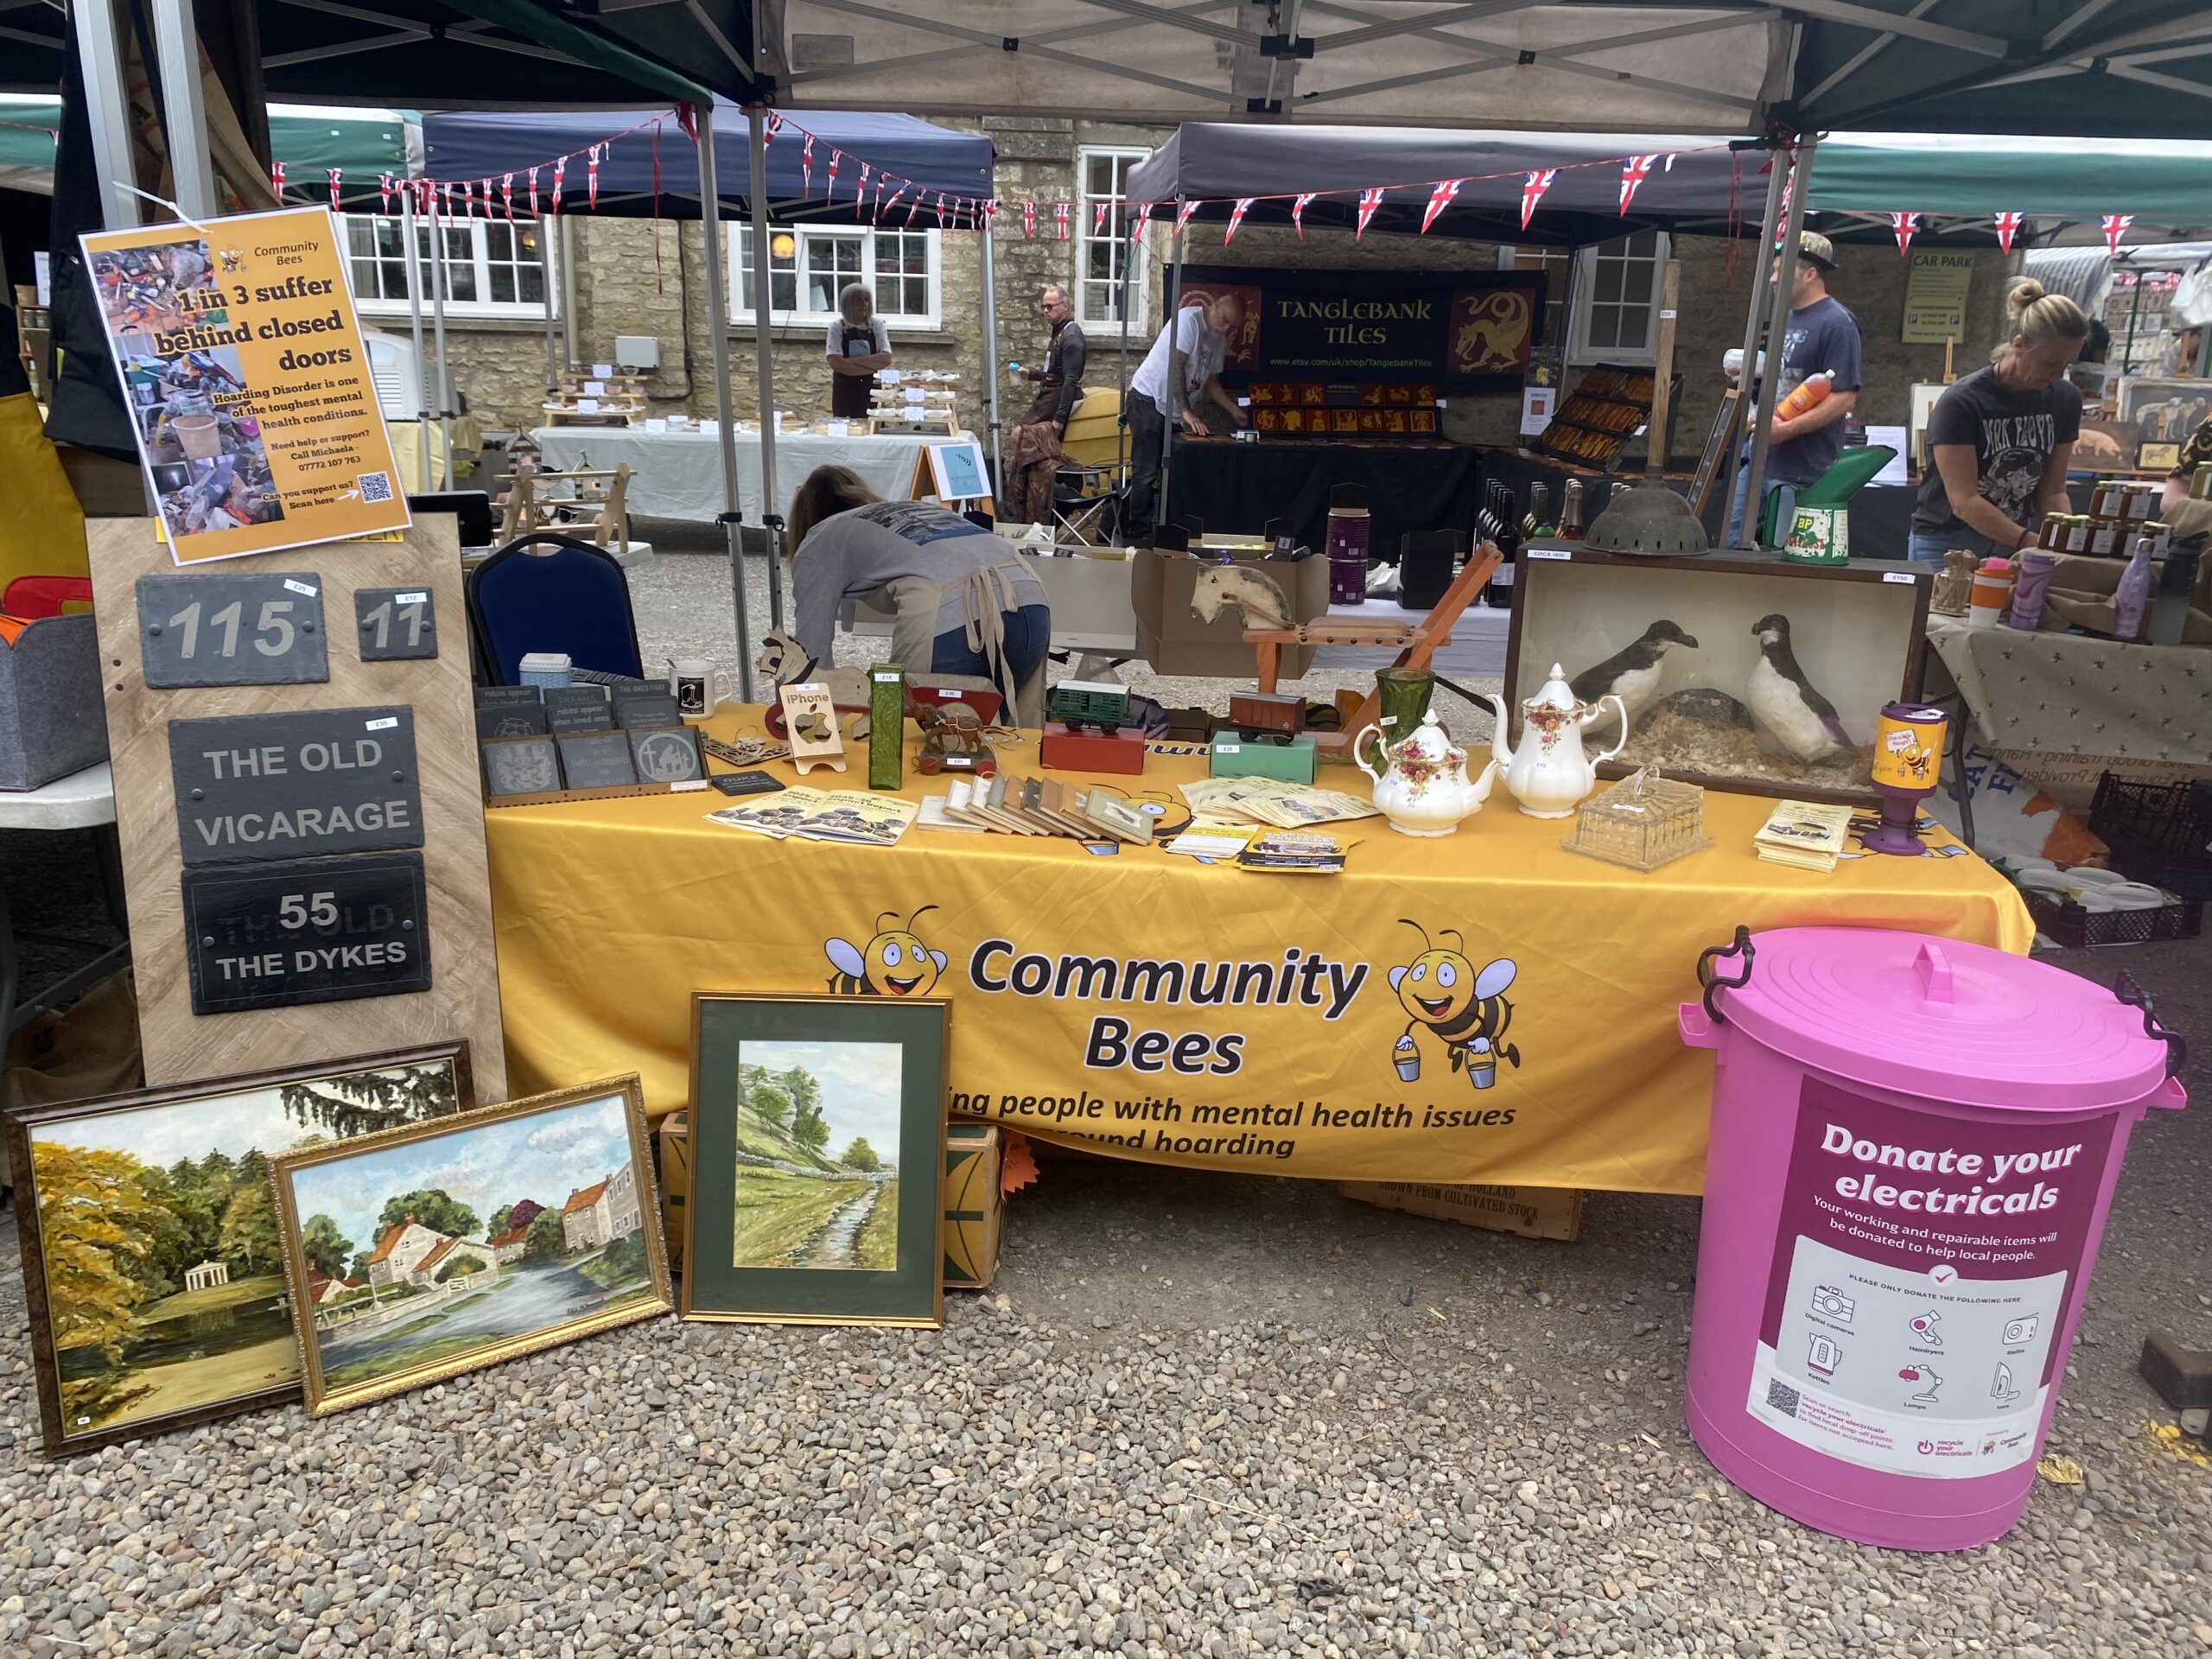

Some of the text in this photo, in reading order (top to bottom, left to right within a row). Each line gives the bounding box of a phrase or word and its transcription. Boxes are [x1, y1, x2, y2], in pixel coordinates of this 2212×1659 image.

[254, 241, 319, 257] Community
[276, 255, 302, 266] Bees
[1913, 255, 1972, 267] CAR PARK
[177, 276, 333, 312] 1 in 3 suffer
[1277, 298, 1433, 321] TANGLEBANK
[153, 309, 345, 354] behind closed
[1324, 323, 1387, 346] TILES
[278, 347, 353, 371] doors
[213, 378, 359, 404] Hoarding Disorder is one
[232, 390, 364, 418] of the toughest mental
[261, 408, 368, 429] health conditions.
[270, 440, 296, 451] Need
[296, 437, 318, 448] help
[331, 429, 370, 442] support?
[290, 445, 354, 460] Call Michaela
[299, 455, 361, 472] 07772 107 763
[263, 481, 354, 502] Can you support us?
[289, 495, 335, 510] Scan here
[1797, 518, 1812, 529] BP
[168, 601, 296, 659] 115
[365, 601, 423, 648] 11
[203, 739, 382, 779] THE OLD
[723, 775, 759, 783] DUKE
[195, 800, 410, 846] VICARAGE
[280, 891, 338, 929] 55
[216, 941, 407, 980] THE DYKES
[971, 939, 1368, 1019] Community
[1087, 1016, 1244, 1074] Bees
[998, 1091, 1104, 1123] people
[1114, 1096, 1183, 1124] with
[1191, 1100, 1302, 1127] mental
[1311, 1103, 1413, 1128] health
[1422, 1106, 1517, 1128] issues
[1153, 1131, 1296, 1159] hoarding
[1821, 1122, 2083, 1185] Donate your
[1415, 1185, 1442, 1201] FROM
[1444, 1190, 1506, 1213] CULTIVATED
[1508, 1202, 1539, 1220] STOCK
[1835, 1173, 2061, 1216] electricals
[1814, 1195, 2057, 1247] Your working and repairable items will
[1829, 1218, 2036, 1263] be donated to help local people.
[1848, 1274, 1879, 1287] PLEASE
[1881, 1283, 1901, 1294] ONLY
[1904, 1289, 1937, 1300] DONATE
[1804, 1312, 1855, 1336] Digital cameras
[1908, 1345, 1945, 1356] Hairdryers
[1808, 1372, 1830, 1386] Kettles
[1802, 1394, 1818, 1405] Scan
[1828, 1405, 1851, 1417] search
[1828, 1413, 1845, 1423] your
[1903, 1402, 1926, 1410] Lamps
[1809, 1418, 1827, 1431] items
[1822, 1417, 1838, 1428] local
[1839, 1424, 1870, 1437] drop-off
[1870, 1434, 1893, 1443] points
